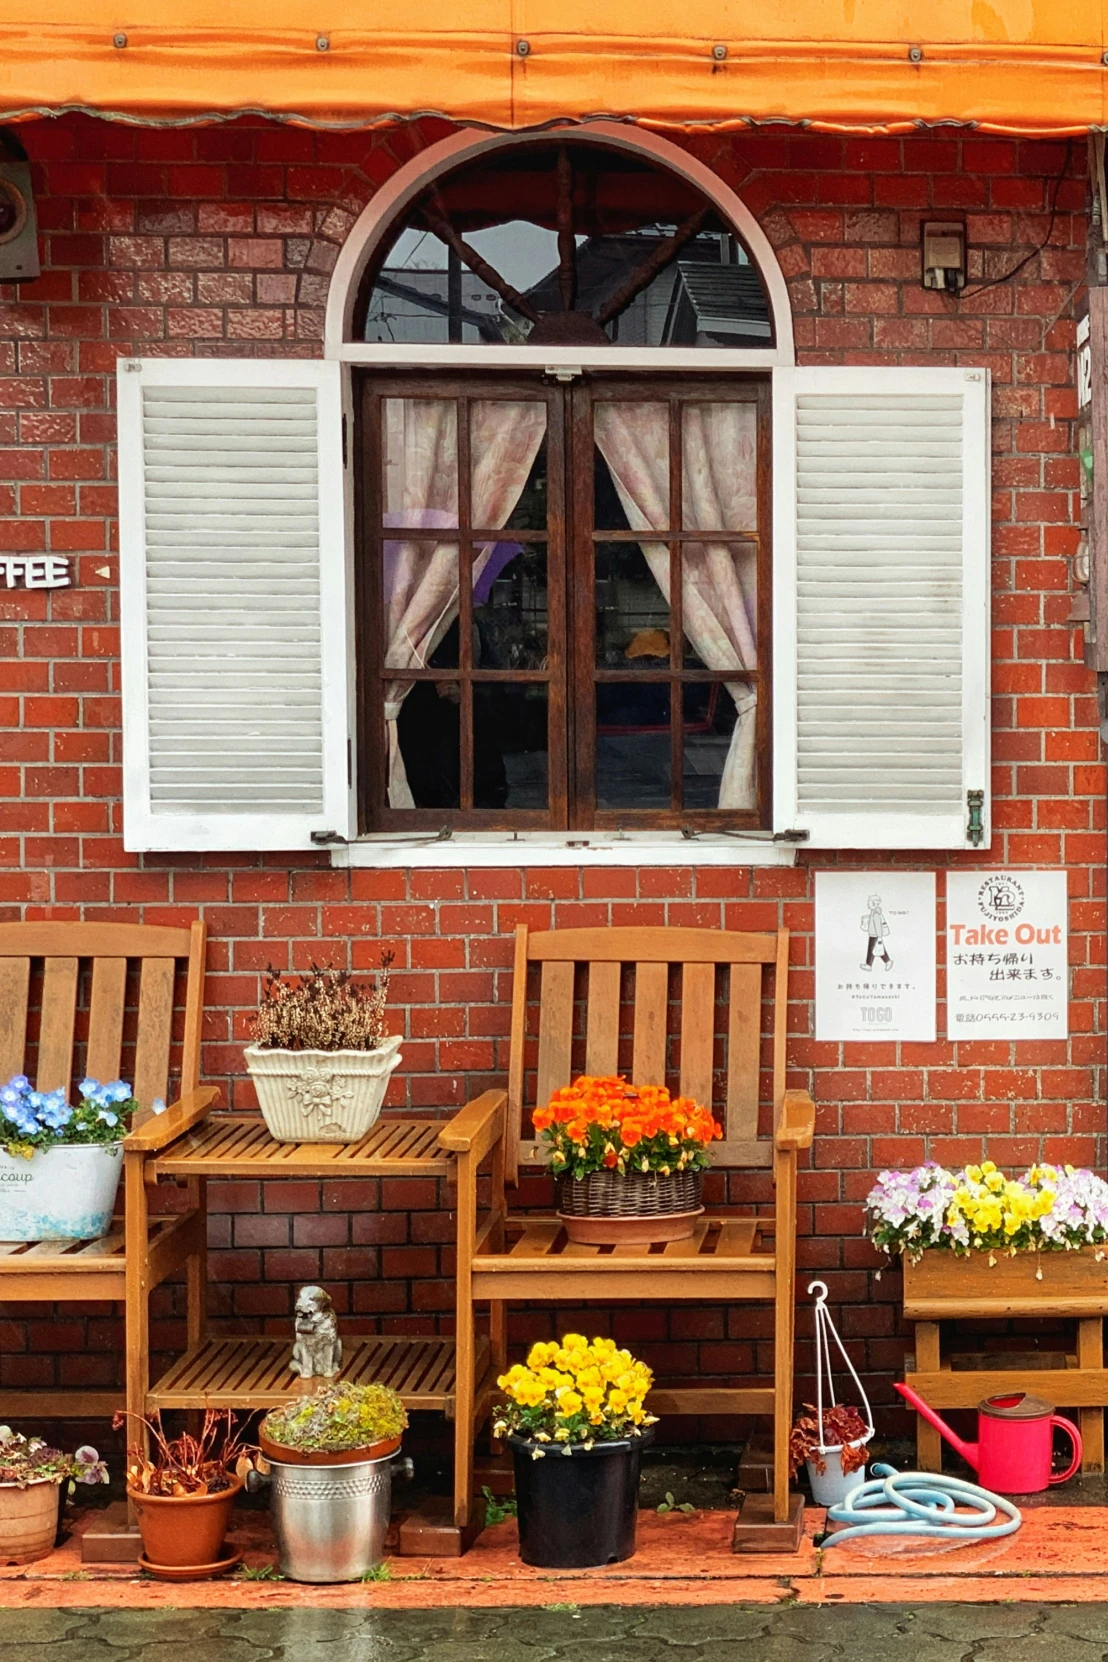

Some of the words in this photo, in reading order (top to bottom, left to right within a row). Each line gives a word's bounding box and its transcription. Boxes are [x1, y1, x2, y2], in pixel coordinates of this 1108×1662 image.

[949, 924, 1009, 946] Take
[1015, 923, 1062, 945] Out
[953, 952, 1033, 966] お持ち帰り
[989, 968, 1062, 981] 出来ます。
[860, 1006, 893, 1022] TOGO
